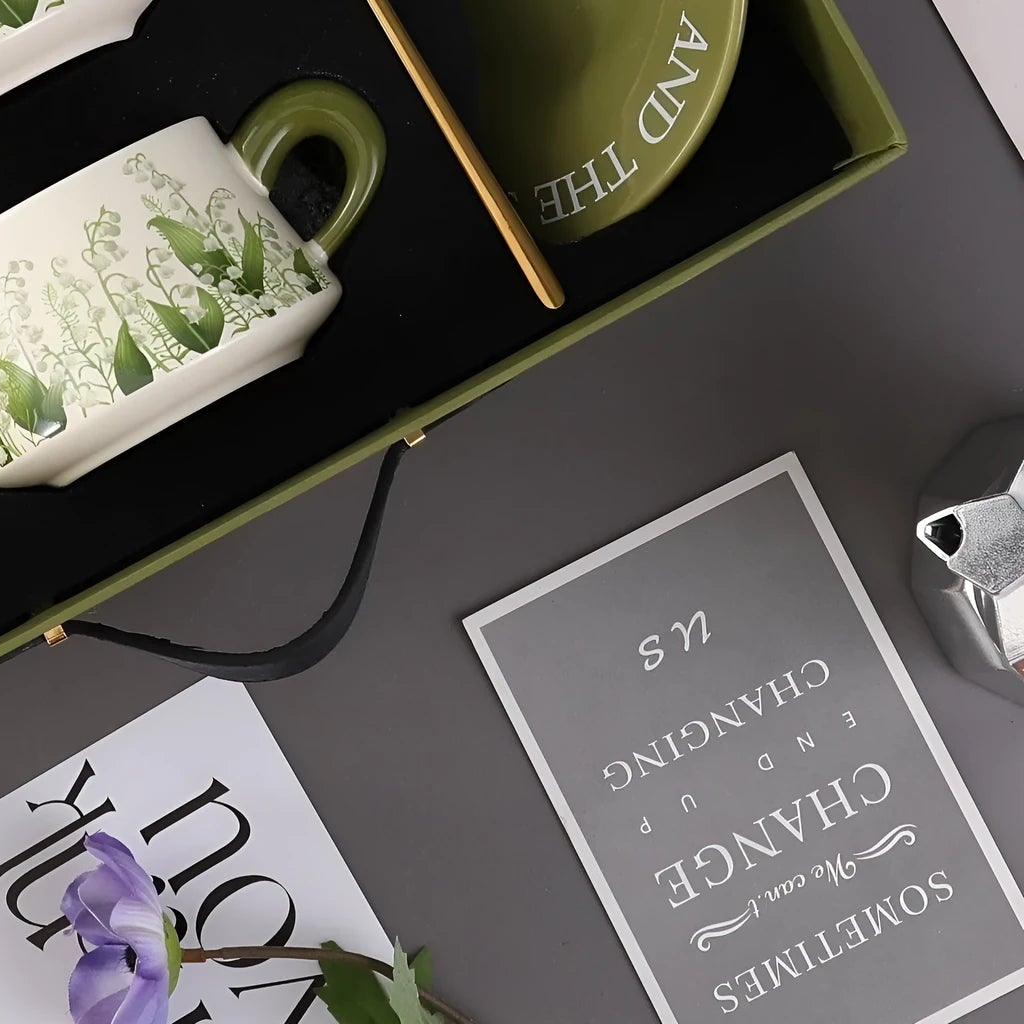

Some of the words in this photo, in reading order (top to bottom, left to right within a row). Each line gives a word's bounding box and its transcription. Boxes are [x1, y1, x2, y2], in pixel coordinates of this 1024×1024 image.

[638, 11, 709, 145] AND
[534, 141, 639, 225] THE
[638, 610, 712, 671] us
[602, 659, 831, 792] CHANGING
[654, 762, 892, 909] CHANGE
[810, 852, 857, 887] We
[713, 869, 954, 1014] SOMETIMES
